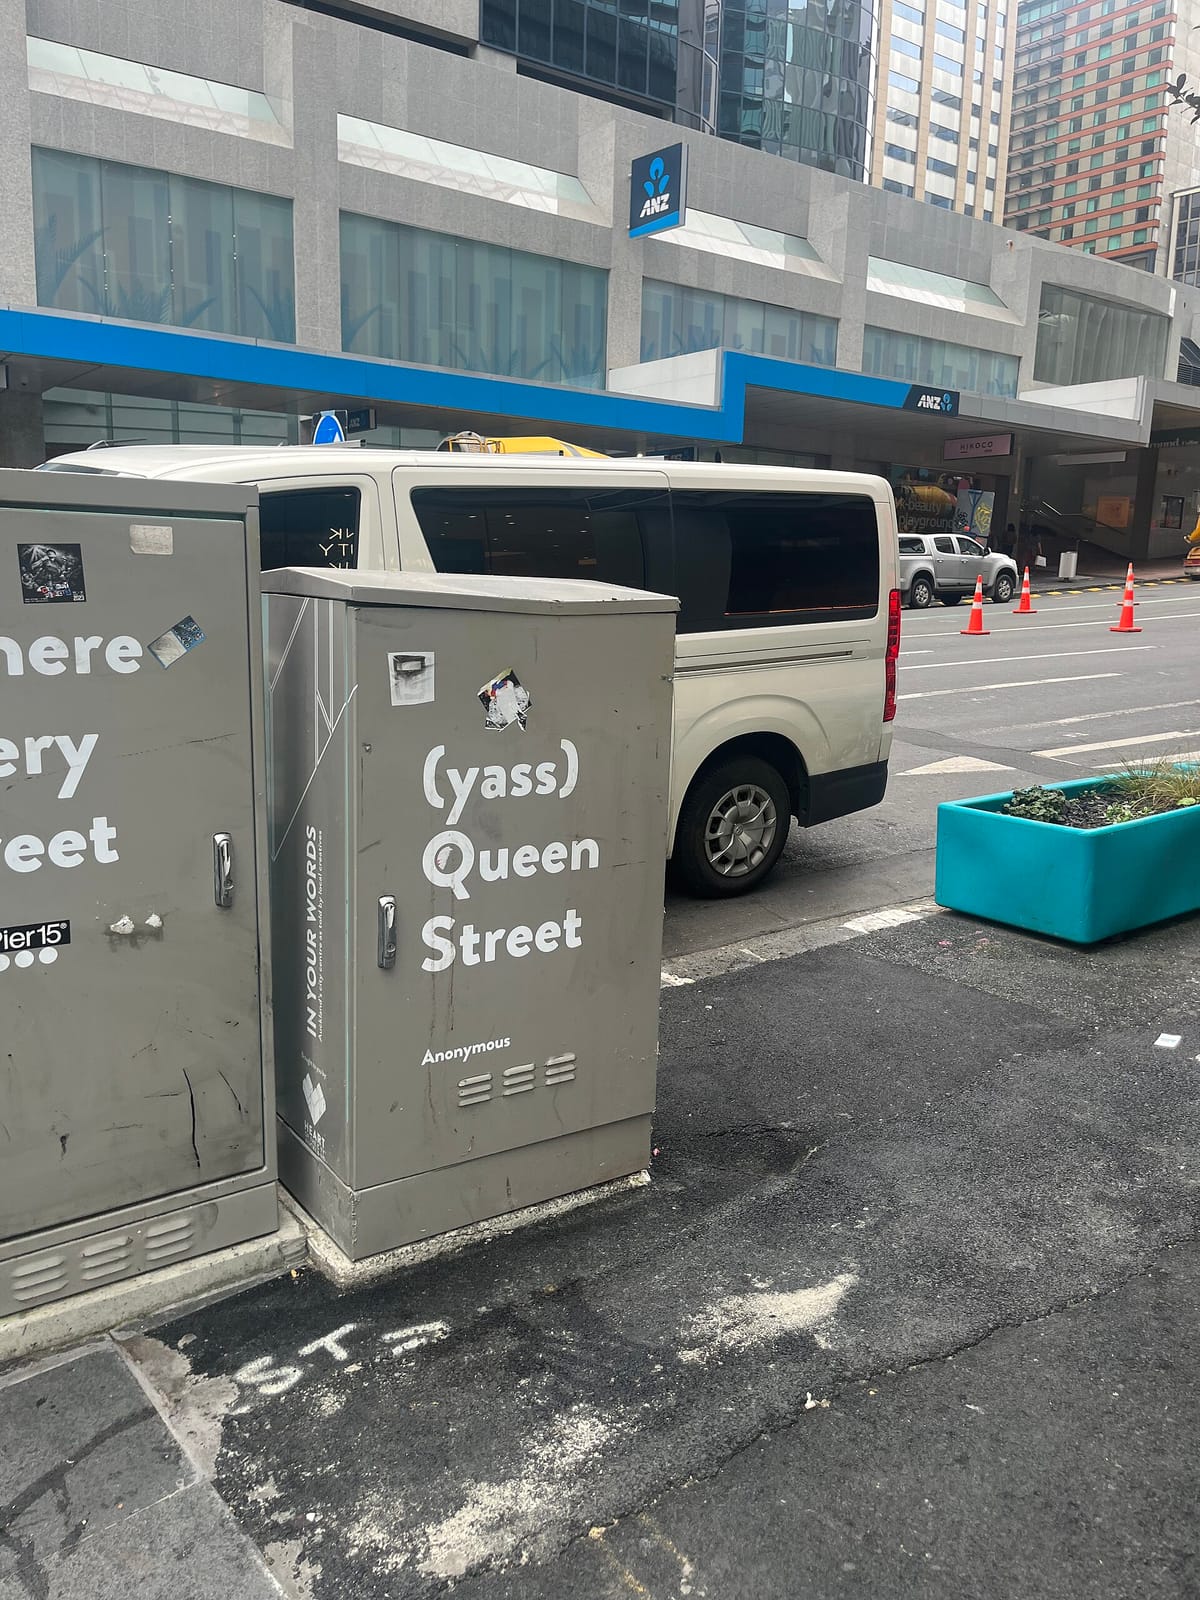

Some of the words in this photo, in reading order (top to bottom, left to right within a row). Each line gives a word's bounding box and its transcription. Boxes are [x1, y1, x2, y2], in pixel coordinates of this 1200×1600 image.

[639, 193, 670, 218] ANZ
[917, 394, 941, 410] ANZ
[960, 441, 993, 451] HIKOCO
[423, 739, 579, 825] (yass)
[0, 816, 120, 873] eet
[422, 830, 600, 900] Queen
[306, 825, 317, 922] WORDS
[306, 928, 317, 1000] YOUR
[421, 909, 582, 972] Street
[306, 1006, 317, 1038] IN
[421, 1037, 511, 1066] Anonymous
